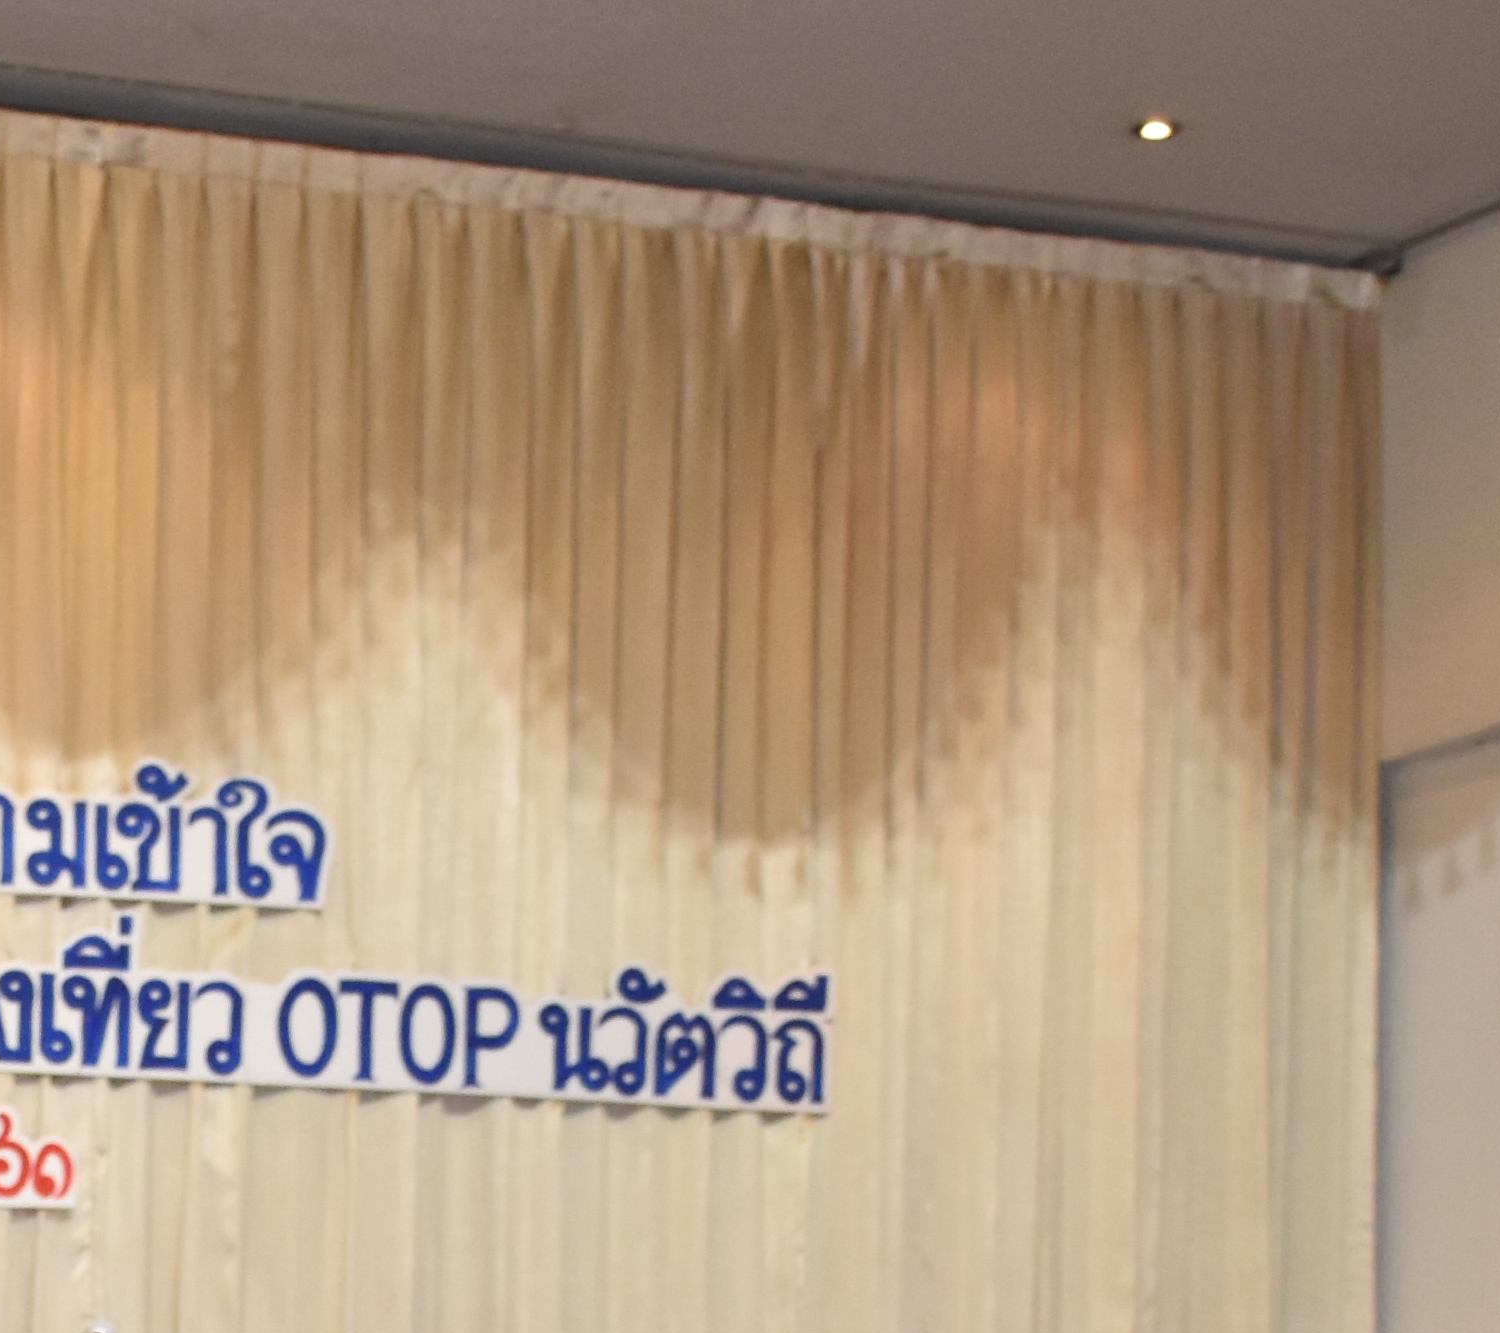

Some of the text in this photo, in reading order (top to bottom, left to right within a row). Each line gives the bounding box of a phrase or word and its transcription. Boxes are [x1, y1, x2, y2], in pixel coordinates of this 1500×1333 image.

[279, 978, 520, 1088] OTOP
[541, 969, 827, 1103] นวัตวิถี
